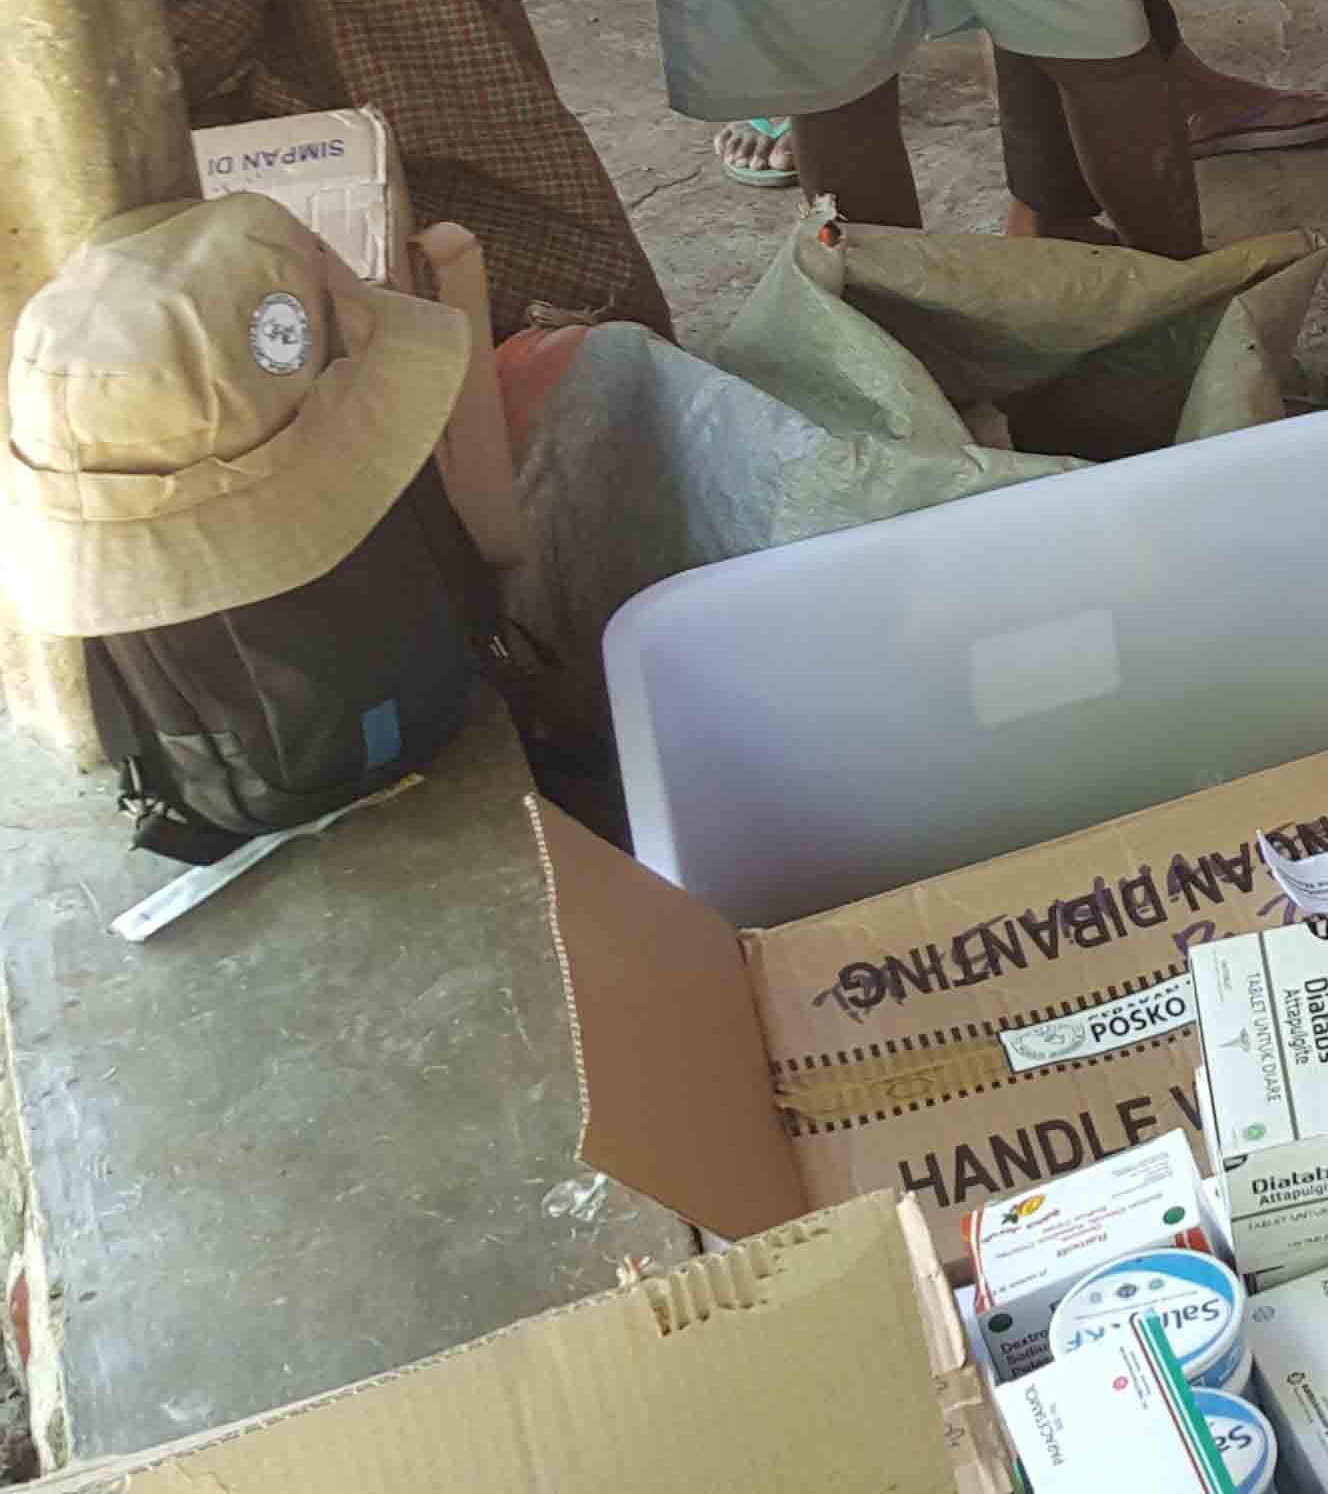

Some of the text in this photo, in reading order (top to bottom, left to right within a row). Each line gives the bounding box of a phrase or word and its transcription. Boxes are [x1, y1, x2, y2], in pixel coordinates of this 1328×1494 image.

[207, 138, 345, 177] SIMPAN DI
[836, 872, 1169, 1009] DIBANTING
[1089, 994, 1188, 1044] POSKO
[898, 1094, 1158, 1209] HANDLE
[1000, 1328, 1050, 1355] Dextro
